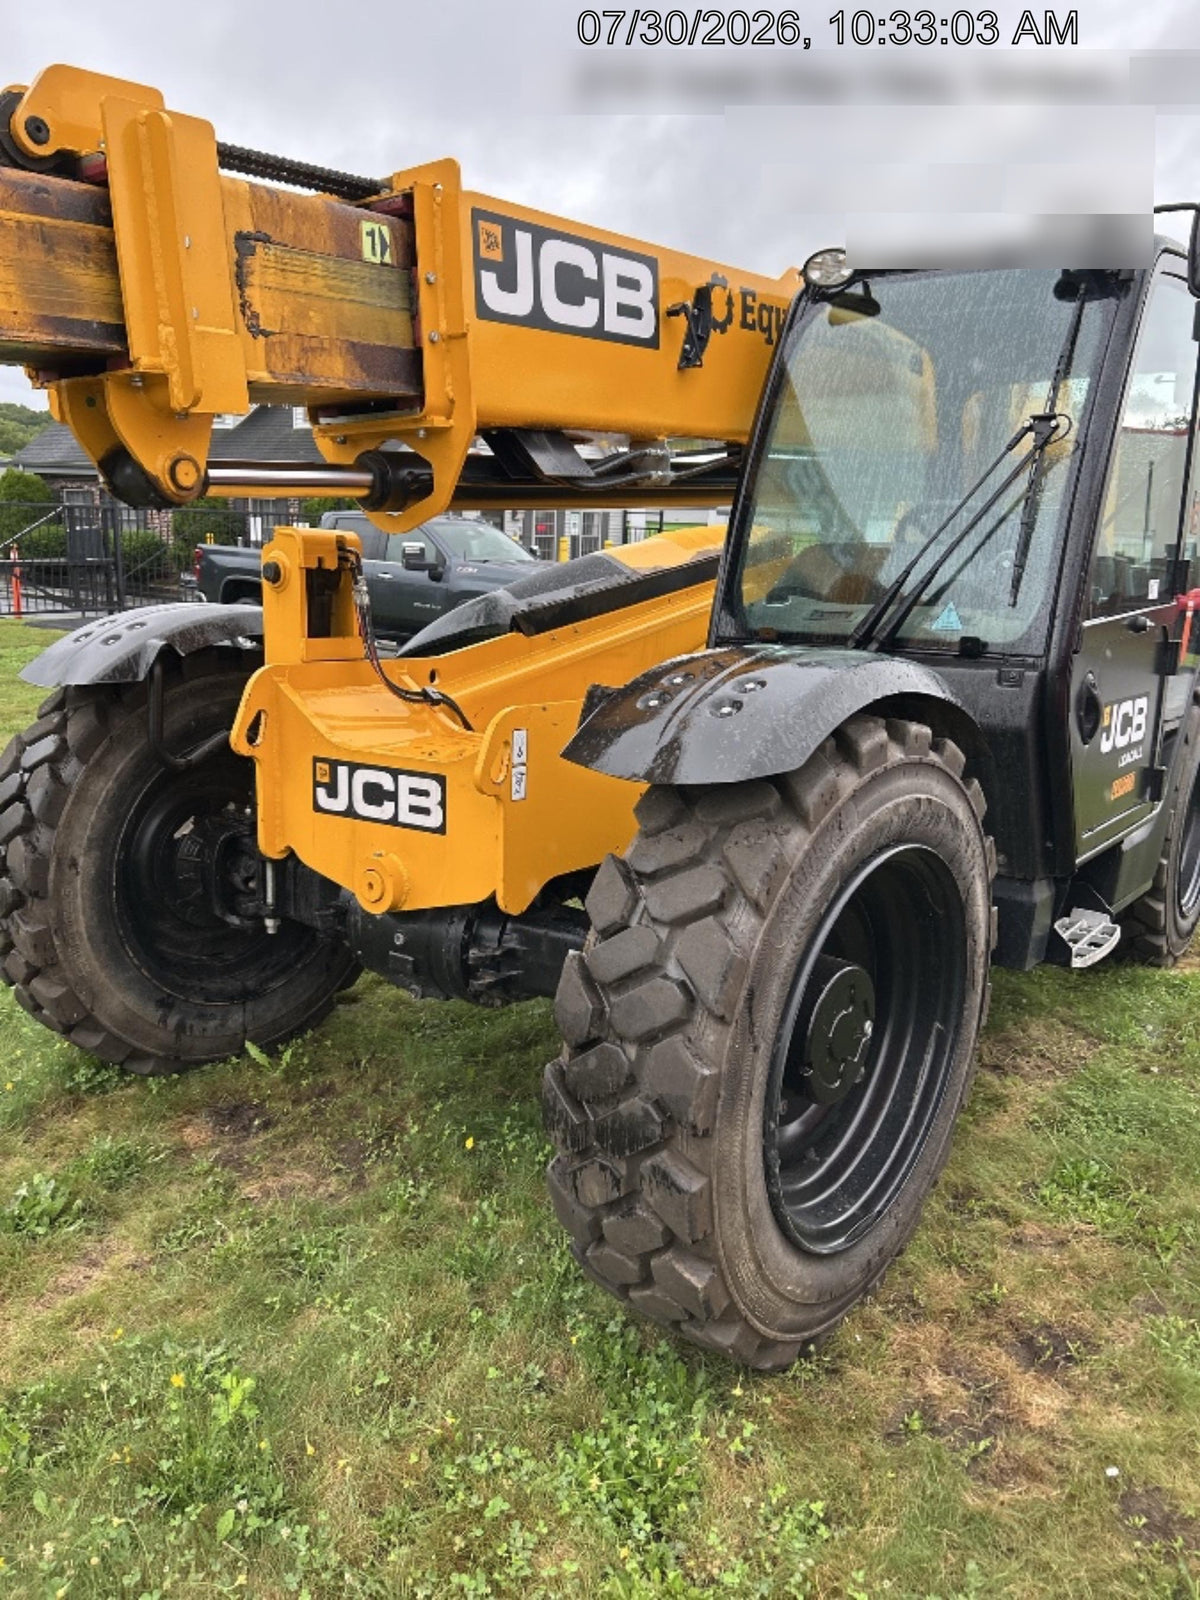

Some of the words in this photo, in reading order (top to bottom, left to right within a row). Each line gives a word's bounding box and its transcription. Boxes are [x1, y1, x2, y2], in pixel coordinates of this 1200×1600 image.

[366, 227, 377, 257] 1
[480, 219, 656, 338] JCB
[1100, 696, 1148, 754] JCB
[316, 765, 443, 828] JCB
